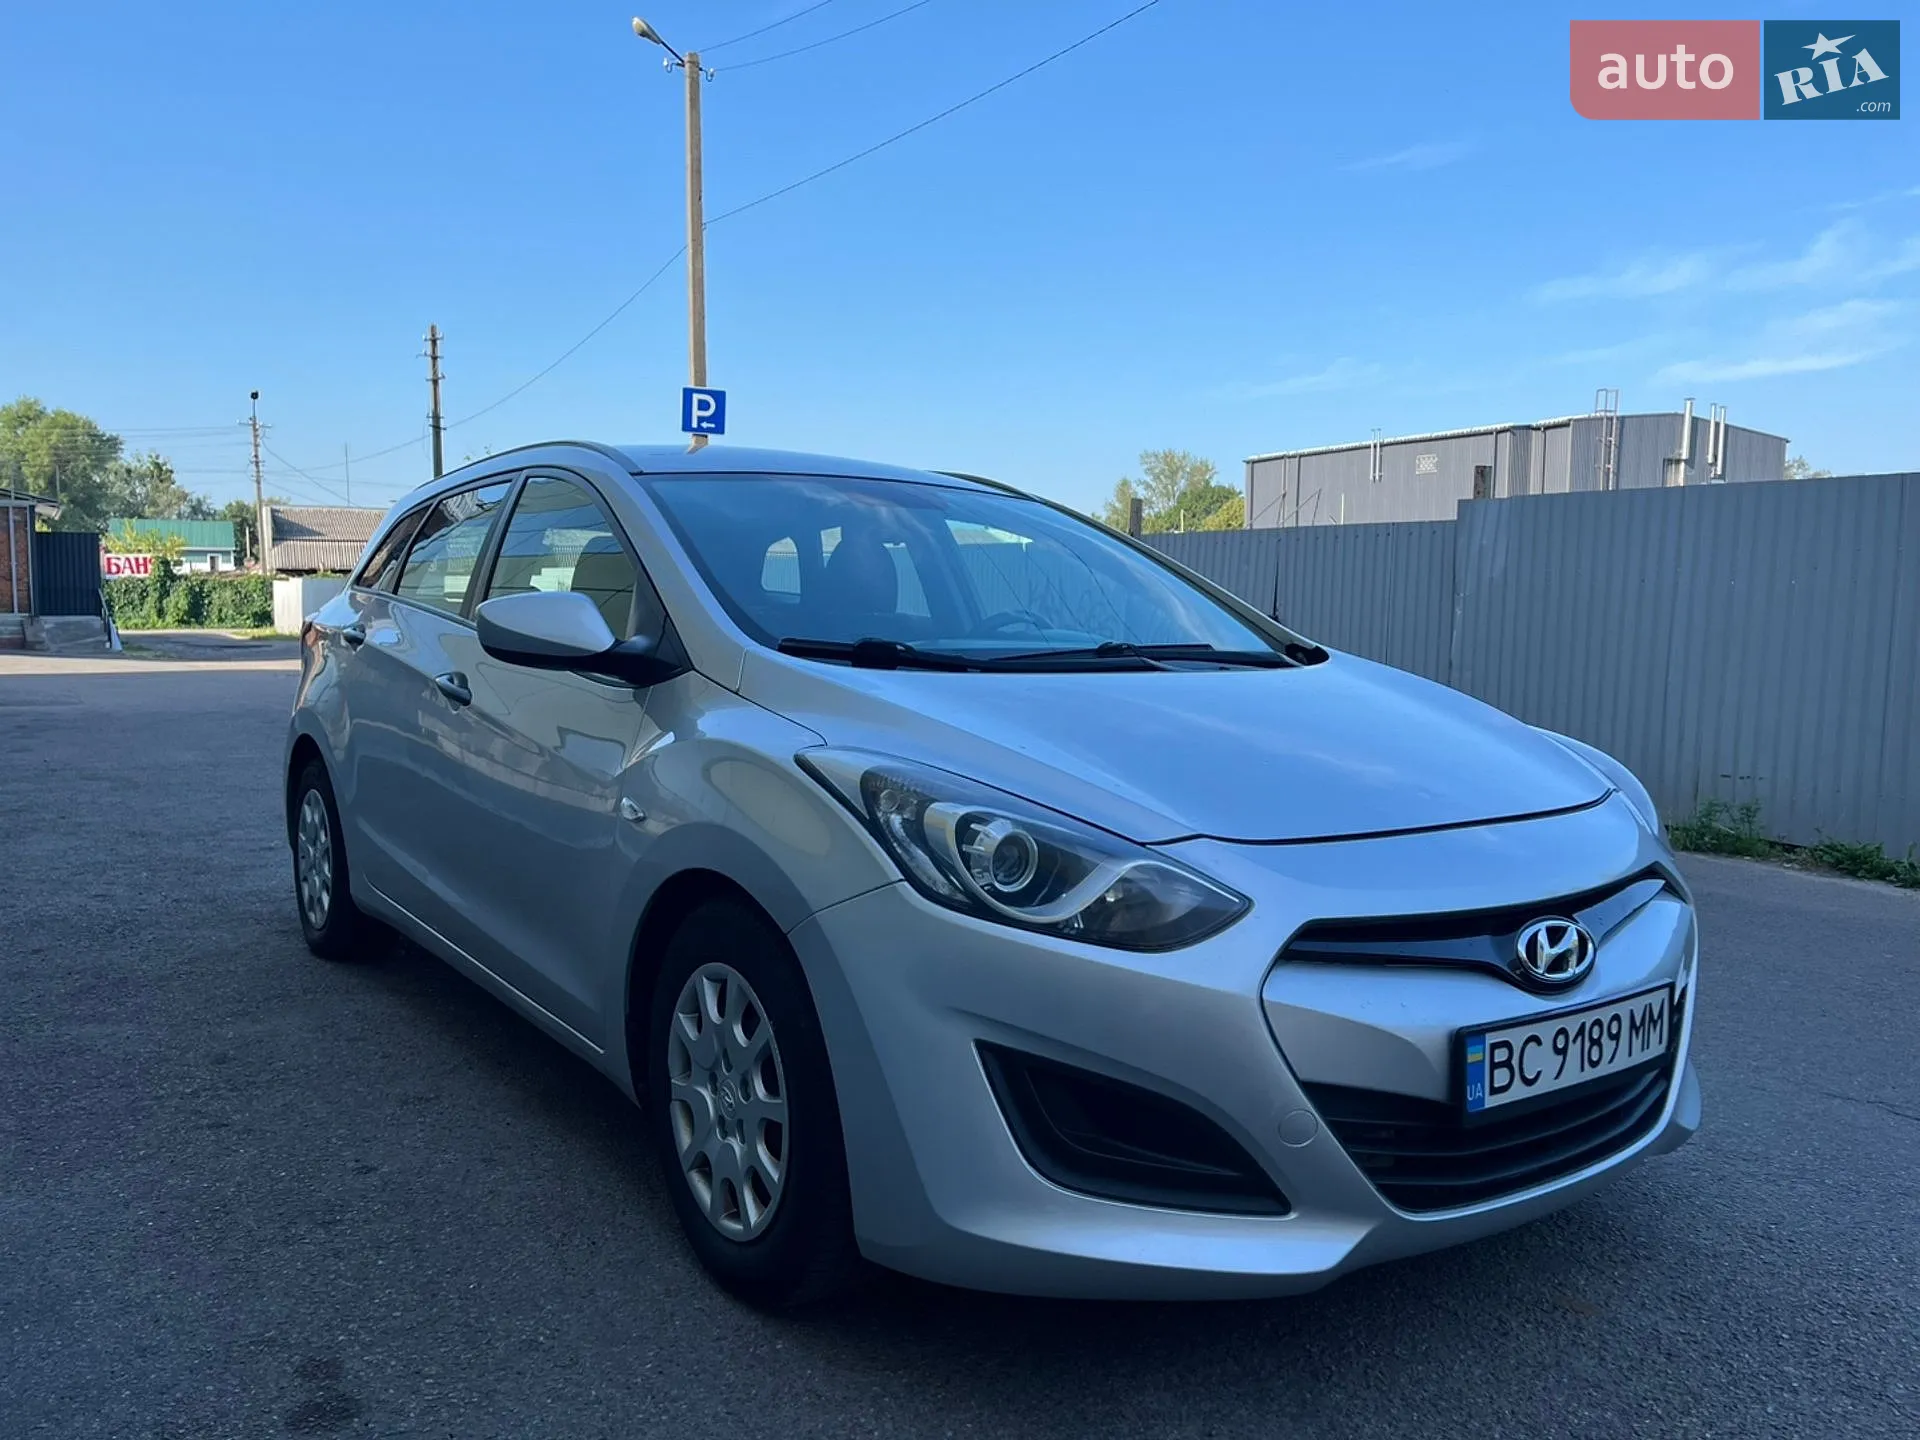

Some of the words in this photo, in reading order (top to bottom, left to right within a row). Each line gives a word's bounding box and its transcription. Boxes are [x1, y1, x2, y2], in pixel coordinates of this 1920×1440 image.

[691, 392, 716, 428] P
[1488, 1033, 1543, 1096] BC
[1552, 1012, 1622, 1081] 9189
[1627, 997, 1666, 1058] MM
[1466, 1083, 1484, 1101] UA
